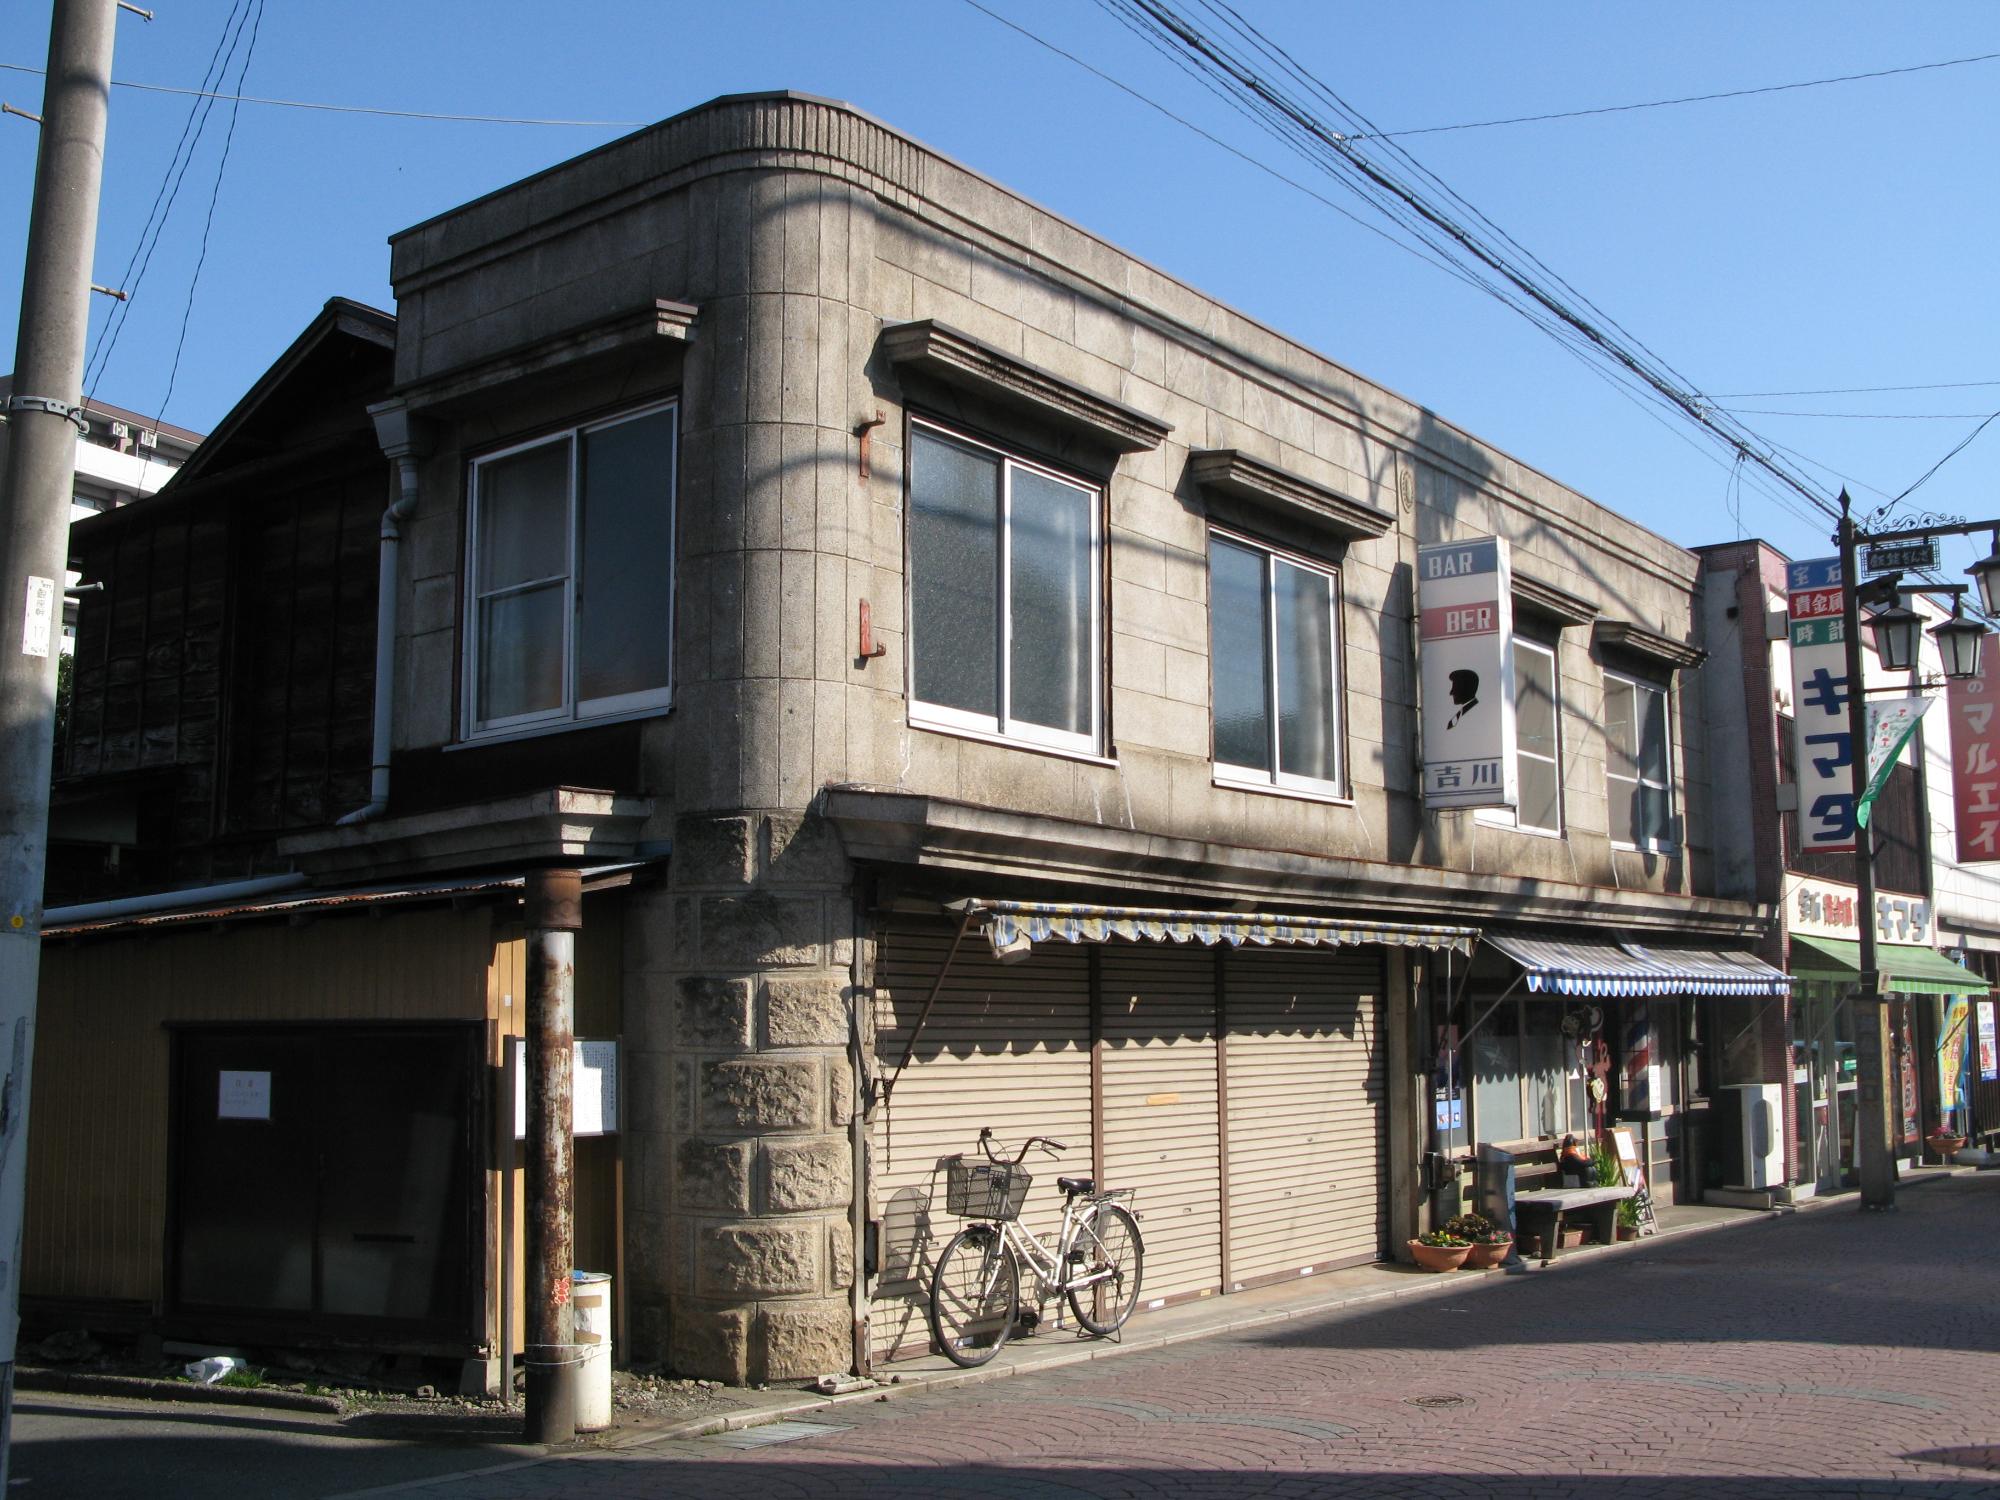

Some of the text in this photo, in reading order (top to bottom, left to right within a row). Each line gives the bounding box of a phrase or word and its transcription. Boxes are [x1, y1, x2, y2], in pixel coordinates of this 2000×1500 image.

[1428, 552, 1473, 578] BAR
[1792, 563, 1841, 587] 宝石
[1795, 592, 1843, 616] 貴金属
[1446, 608, 1491, 633] BER
[1796, 621, 1845, 643] 時計
[1802, 667, 1856, 842] キマタ
[1435, 763, 1497, 788] 吉川
